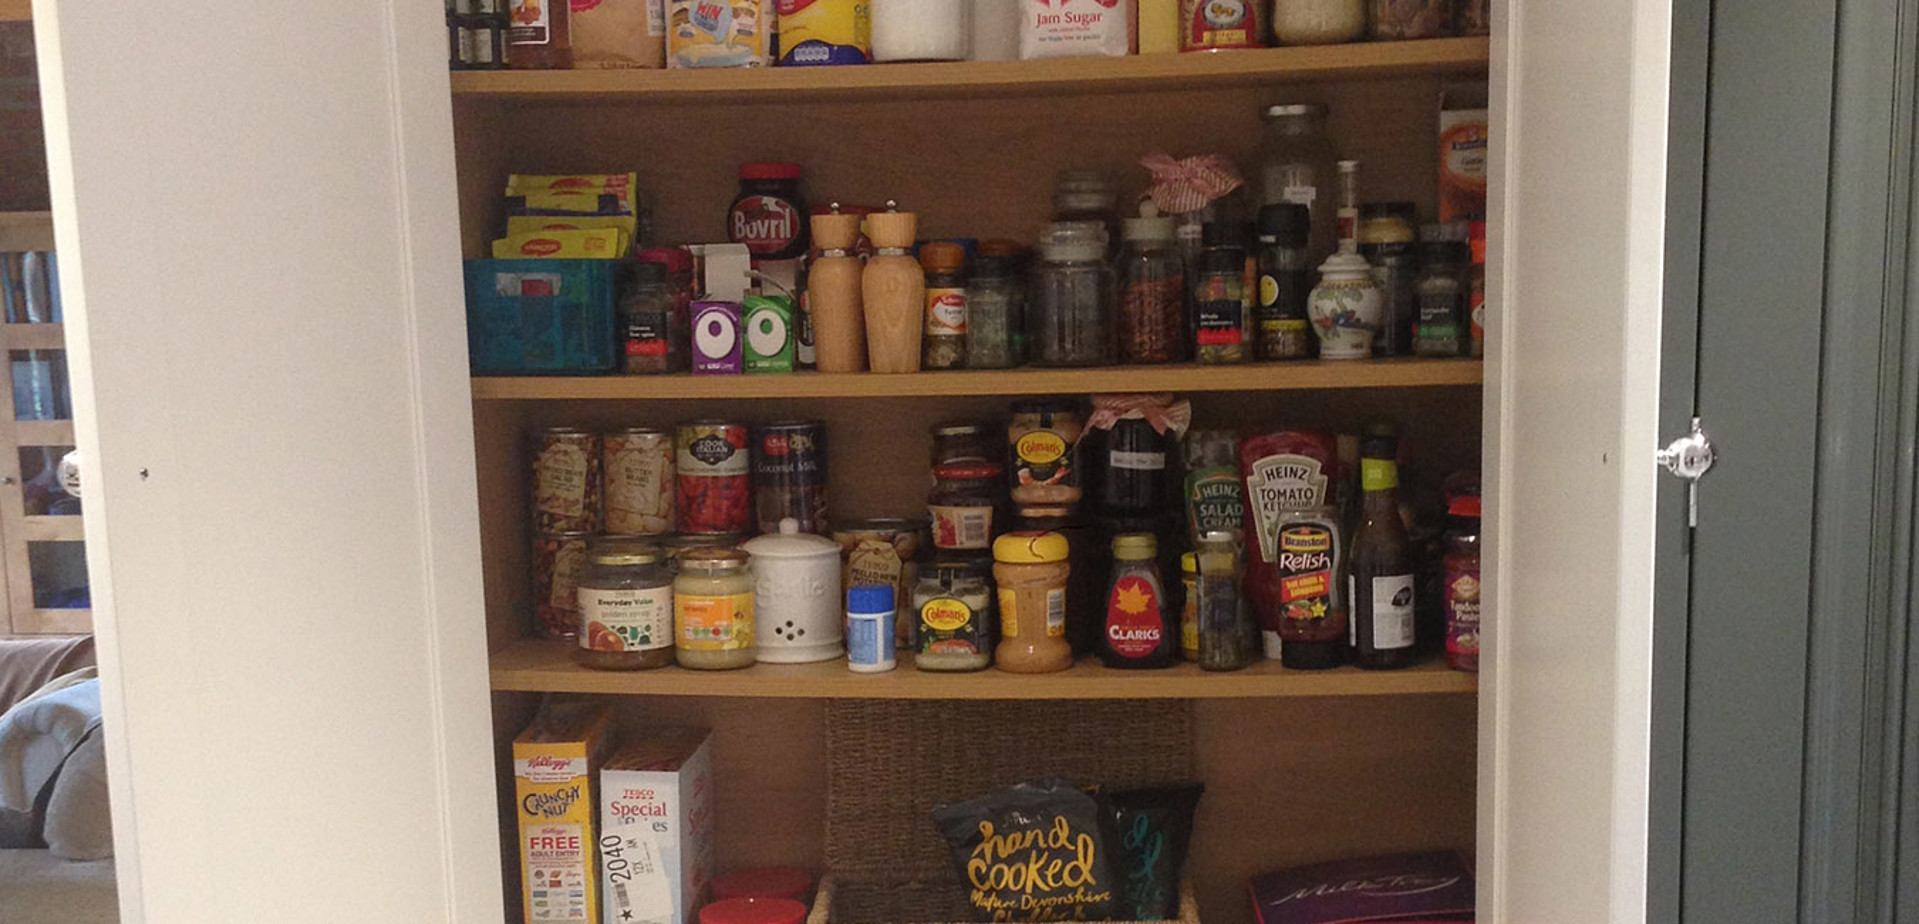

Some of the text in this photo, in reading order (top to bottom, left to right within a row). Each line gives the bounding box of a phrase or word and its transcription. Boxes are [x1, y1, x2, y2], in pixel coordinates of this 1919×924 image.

[1036, 11, 1103, 28] Jam Sugar
[735, 208, 791, 240] Bovril
[1020, 441, 1062, 456] Colman's
[1265, 465, 1309, 482] HEINZ
[1202, 483, 1241, 498] HEINZ
[1260, 487, 1314, 501] TOMATO
[1200, 503, 1244, 517] SALAD
[1279, 552, 1332, 573] Relish
[598, 598, 632, 607] Everyday
[926, 606, 966, 623] Colman's
[1109, 624, 1160, 640] CLARKS
[528, 755, 572, 770] Kellogg's
[522, 785, 580, 816] CRUNCHY
[623, 789, 654, 799] TESCO
[543, 802, 572, 819] NUT
[611, 800, 667, 819] Special
[530, 836, 580, 849] FREE
[971, 815, 1075, 863] hand
[600, 835, 632, 884] 2040
[967, 833, 1096, 894] cooked
[970, 889, 1018, 912] Mature
[1021, 886, 1112, 910] Devonshire
